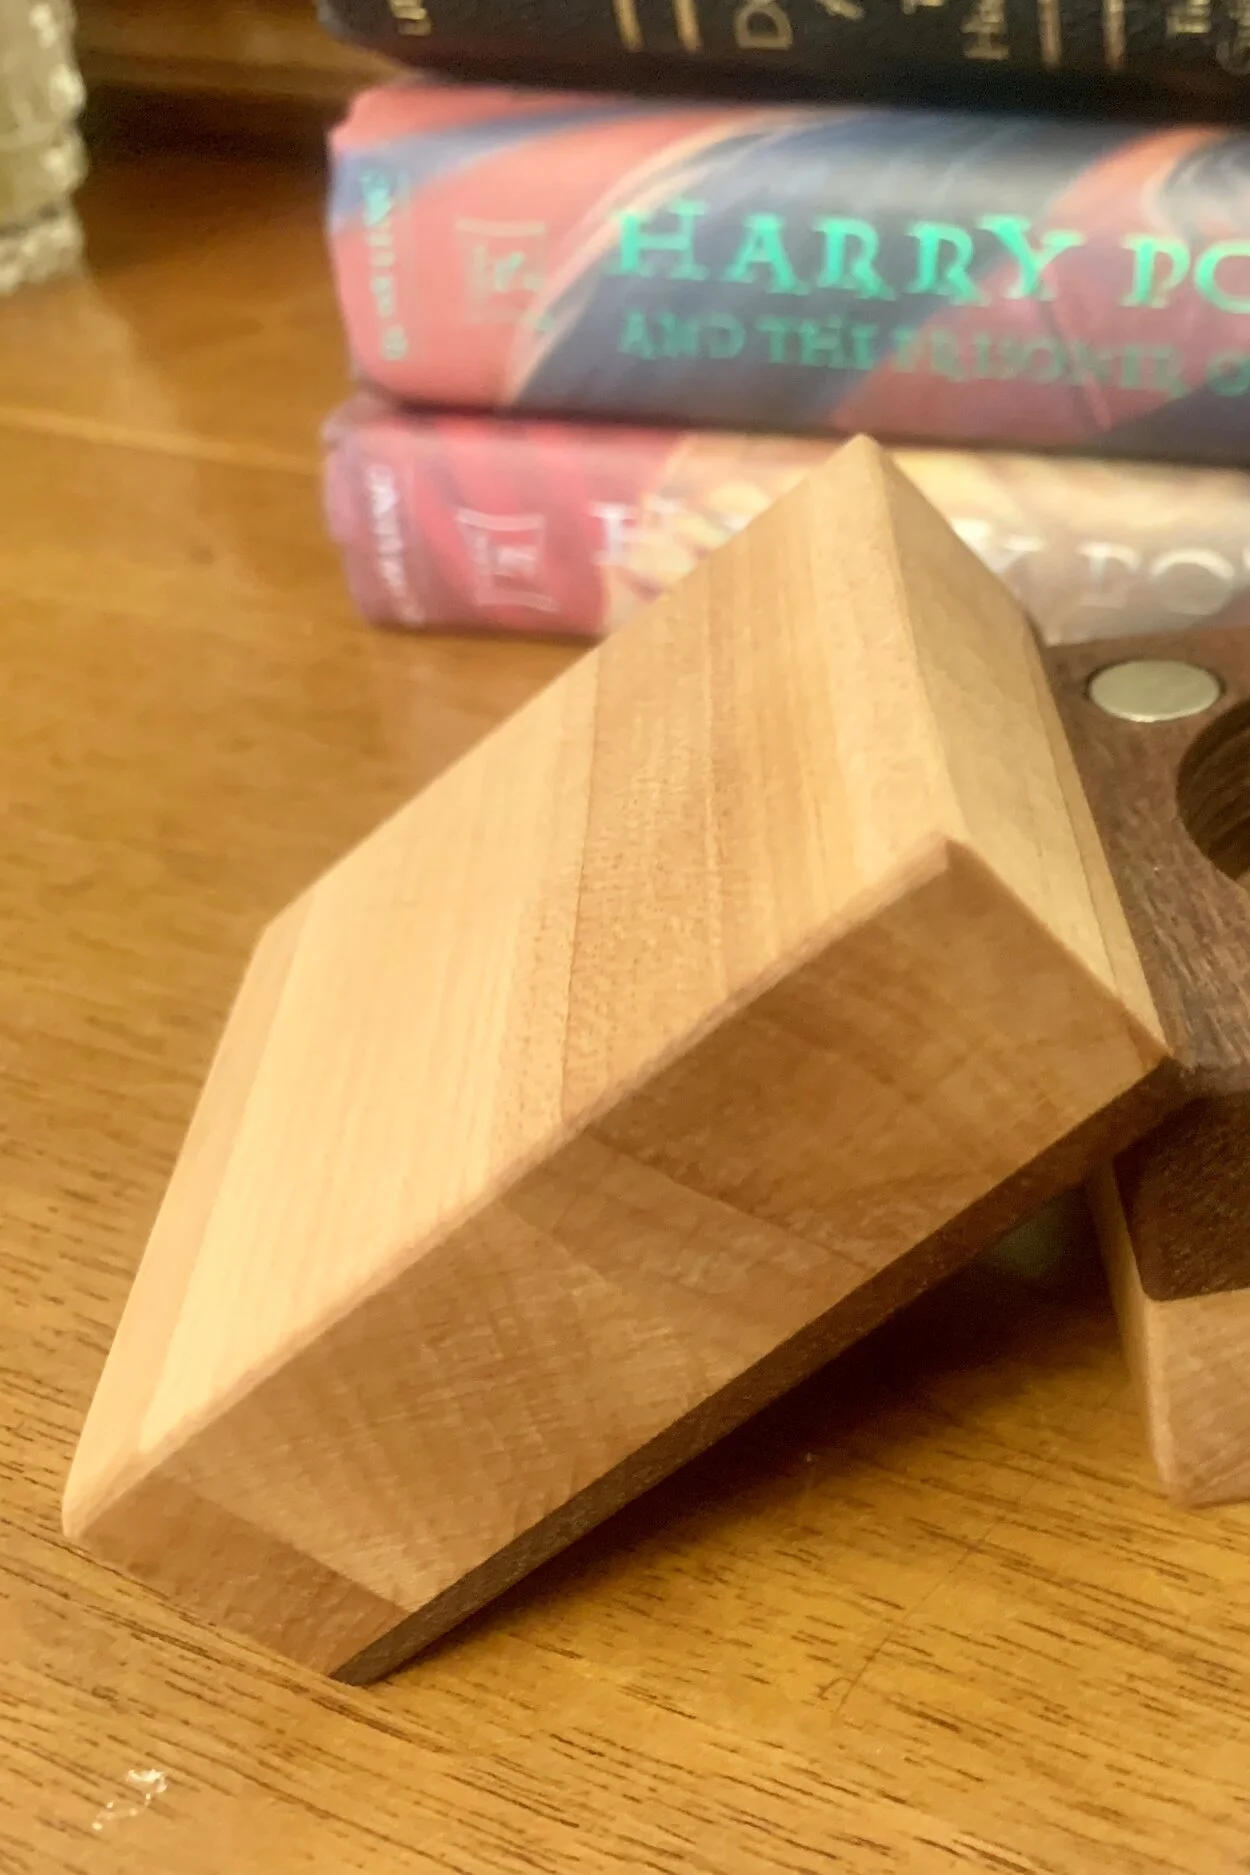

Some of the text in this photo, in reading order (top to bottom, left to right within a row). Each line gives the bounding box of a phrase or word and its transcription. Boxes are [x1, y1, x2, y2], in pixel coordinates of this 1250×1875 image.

[606, 199, 1086, 307] HARRY
[617, 310, 748, 360] AND
[754, 314, 881, 371] THE
